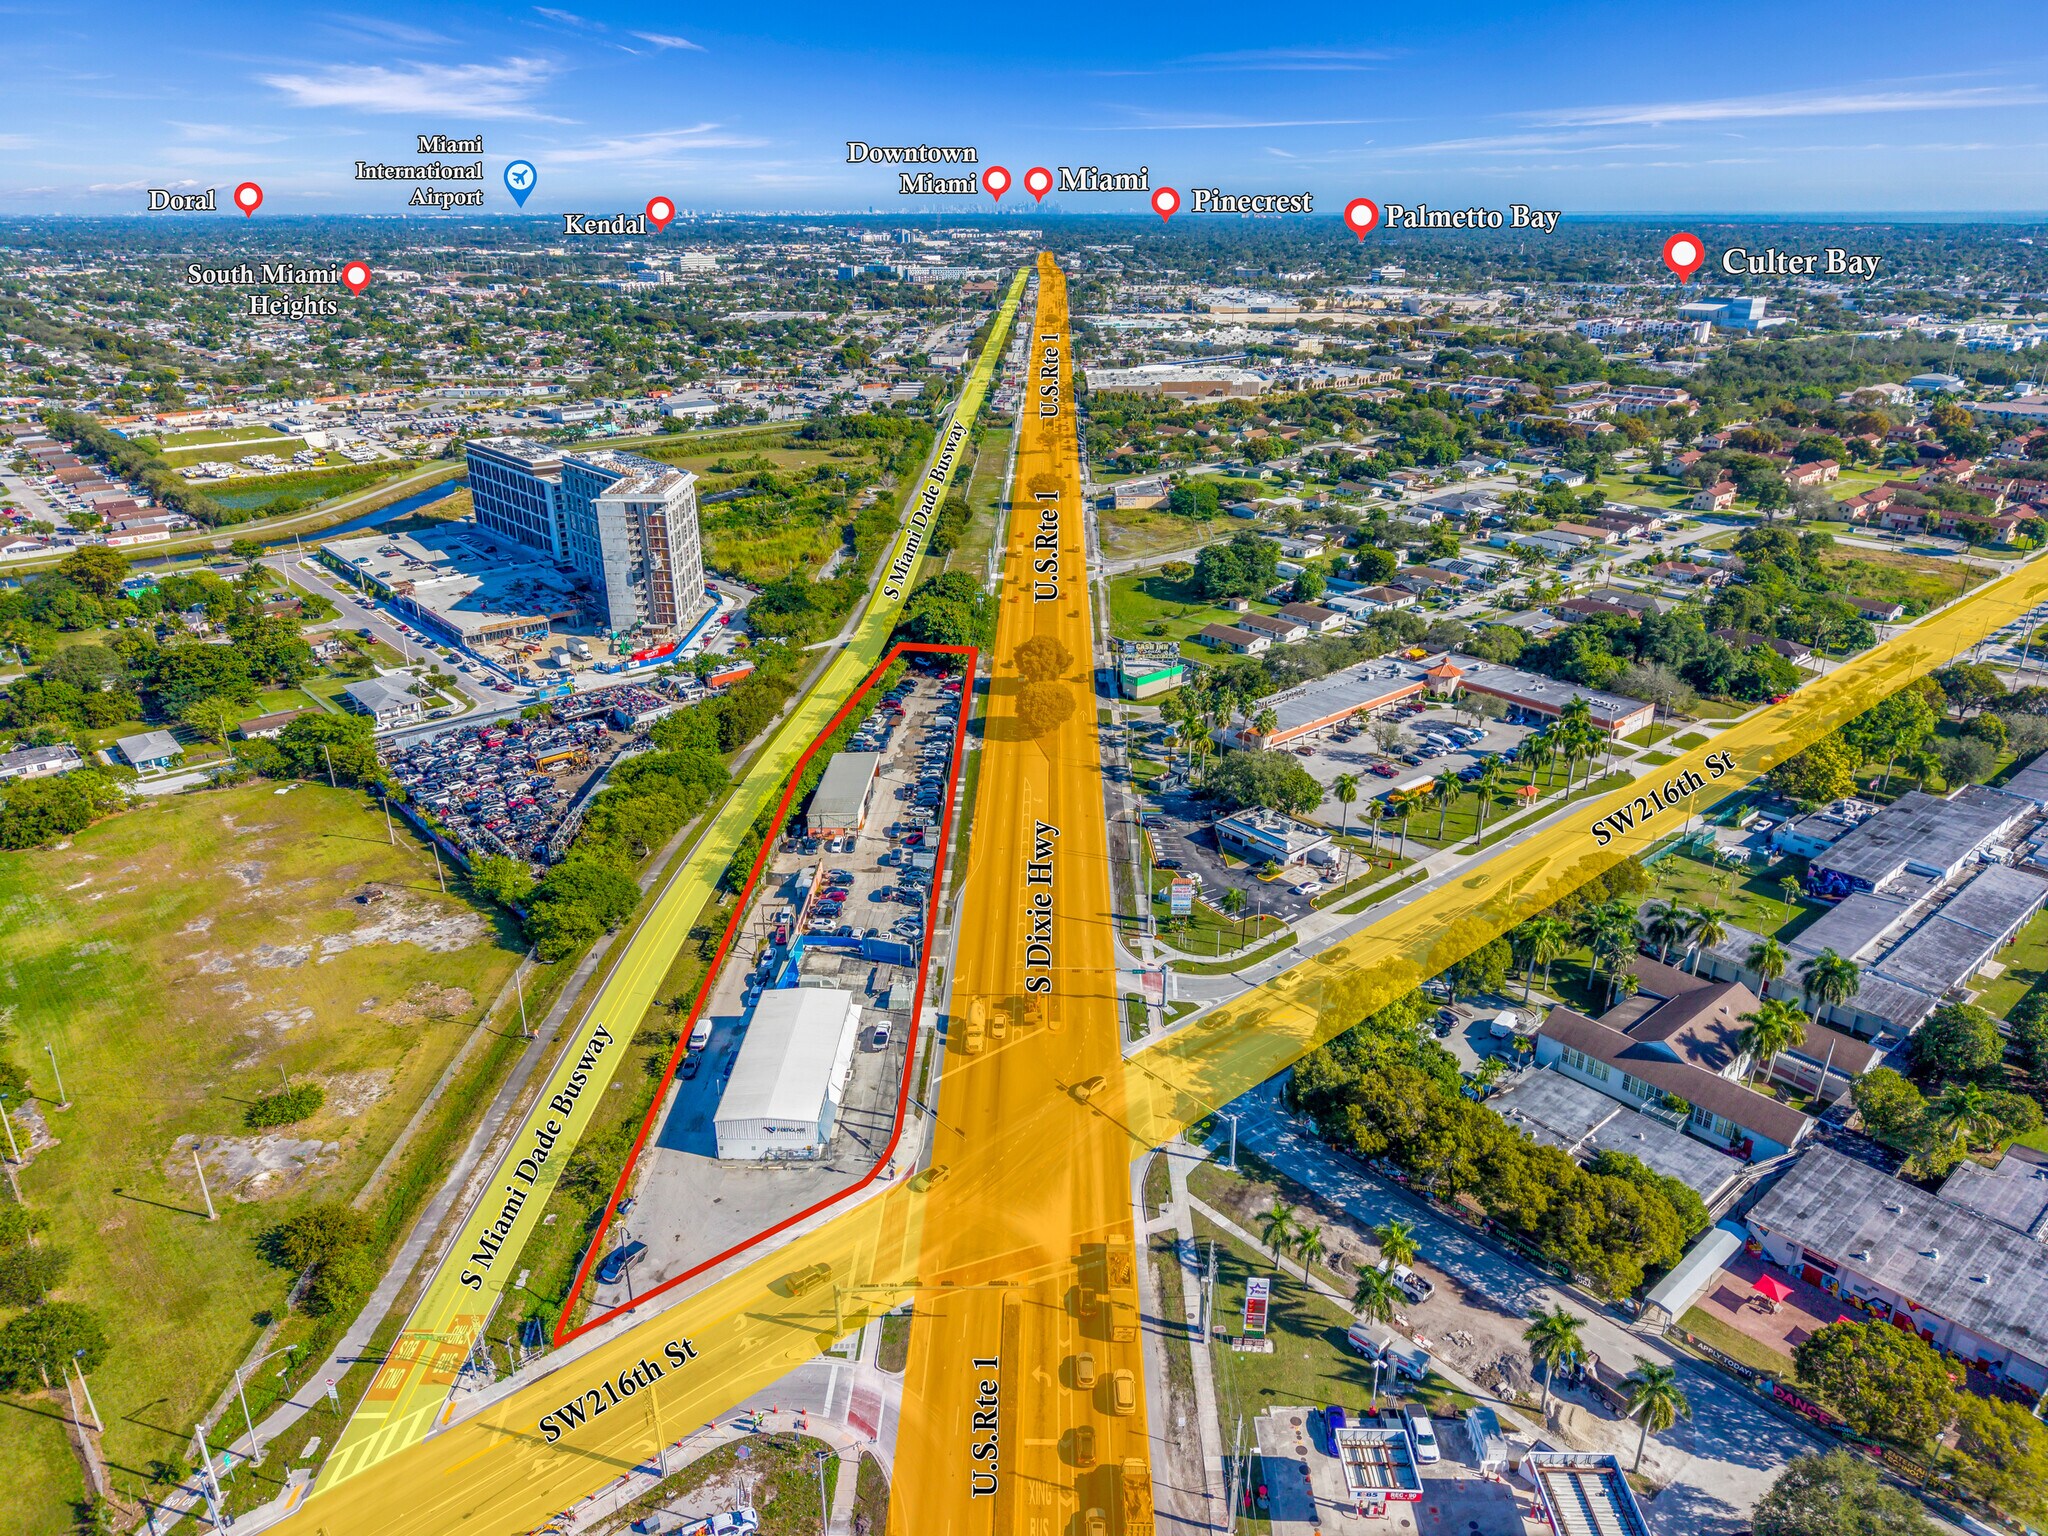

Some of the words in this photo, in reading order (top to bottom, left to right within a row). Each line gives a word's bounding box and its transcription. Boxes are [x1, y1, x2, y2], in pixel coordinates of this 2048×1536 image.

[1697, 1342, 1722, 1360] APPLY
[1723, 1356, 1752, 1377] TODAY!
[1773, 1385, 1831, 1424] DANCE
[1028, 1480, 1052, 1505] XING
